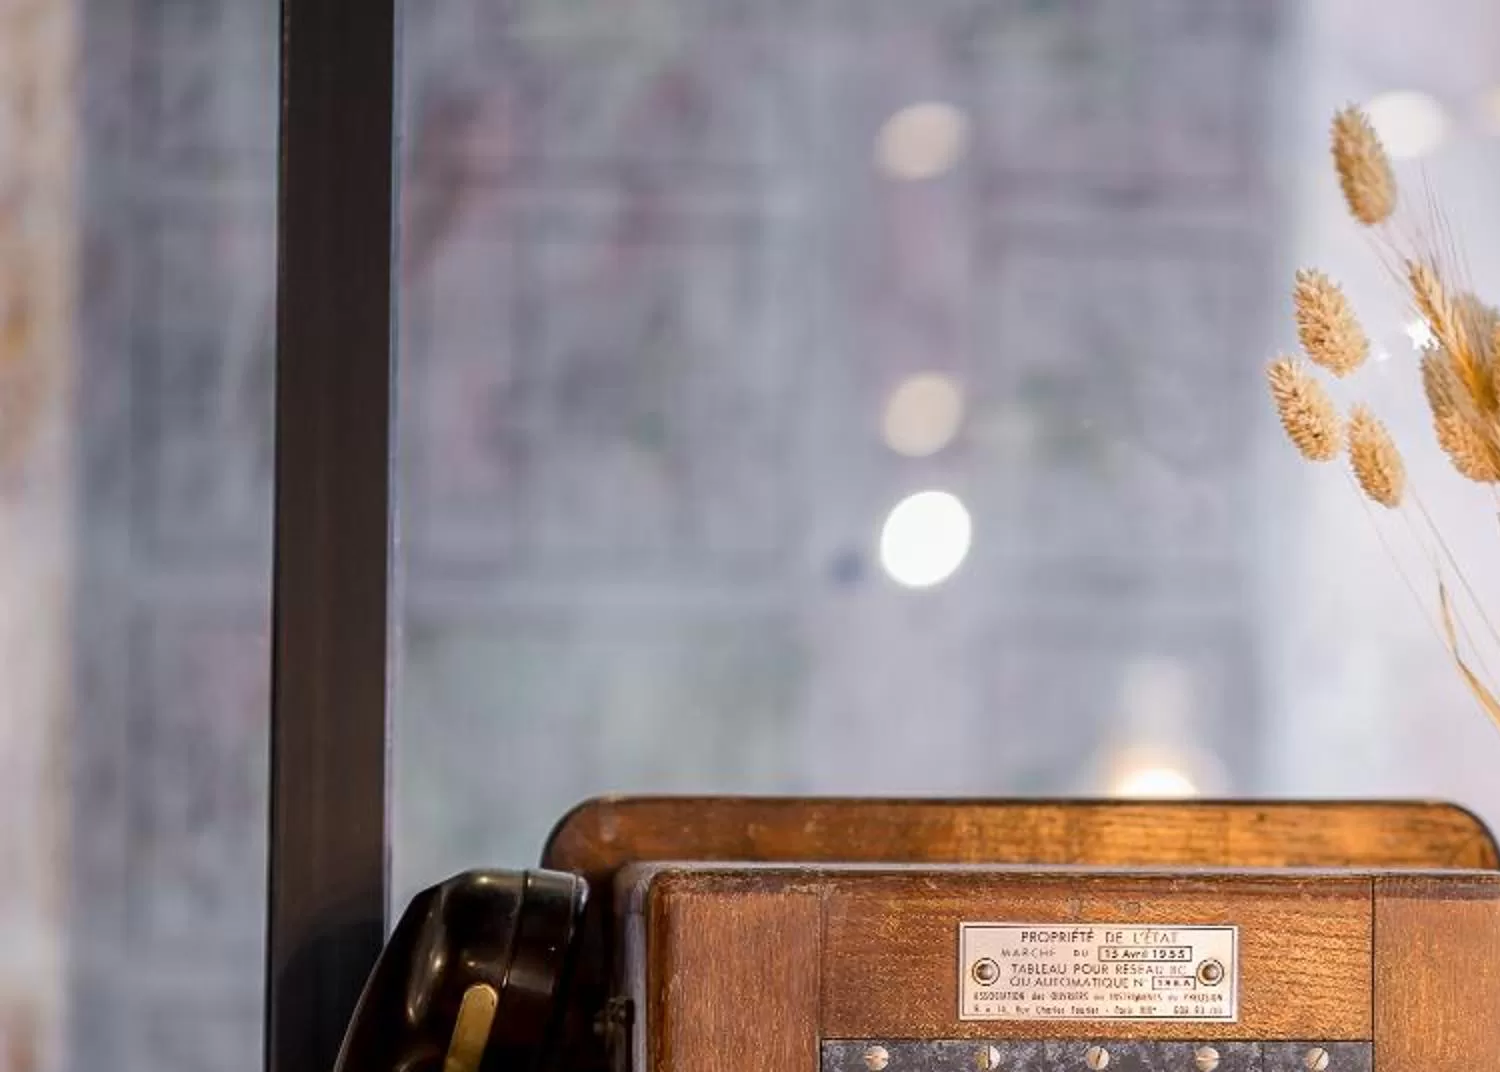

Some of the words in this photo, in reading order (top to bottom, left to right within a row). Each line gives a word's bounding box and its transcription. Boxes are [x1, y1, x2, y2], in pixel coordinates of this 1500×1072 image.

[1105, 931, 1124, 943] DE
[1073, 948, 1089, 957] DU
[1011, 963, 1067, 975] TABLEAU
[1073, 963, 1109, 975] POUR
[1009, 976, 1031, 987] OU
[1034, 977, 1129, 988] AUTOMATIQUE
